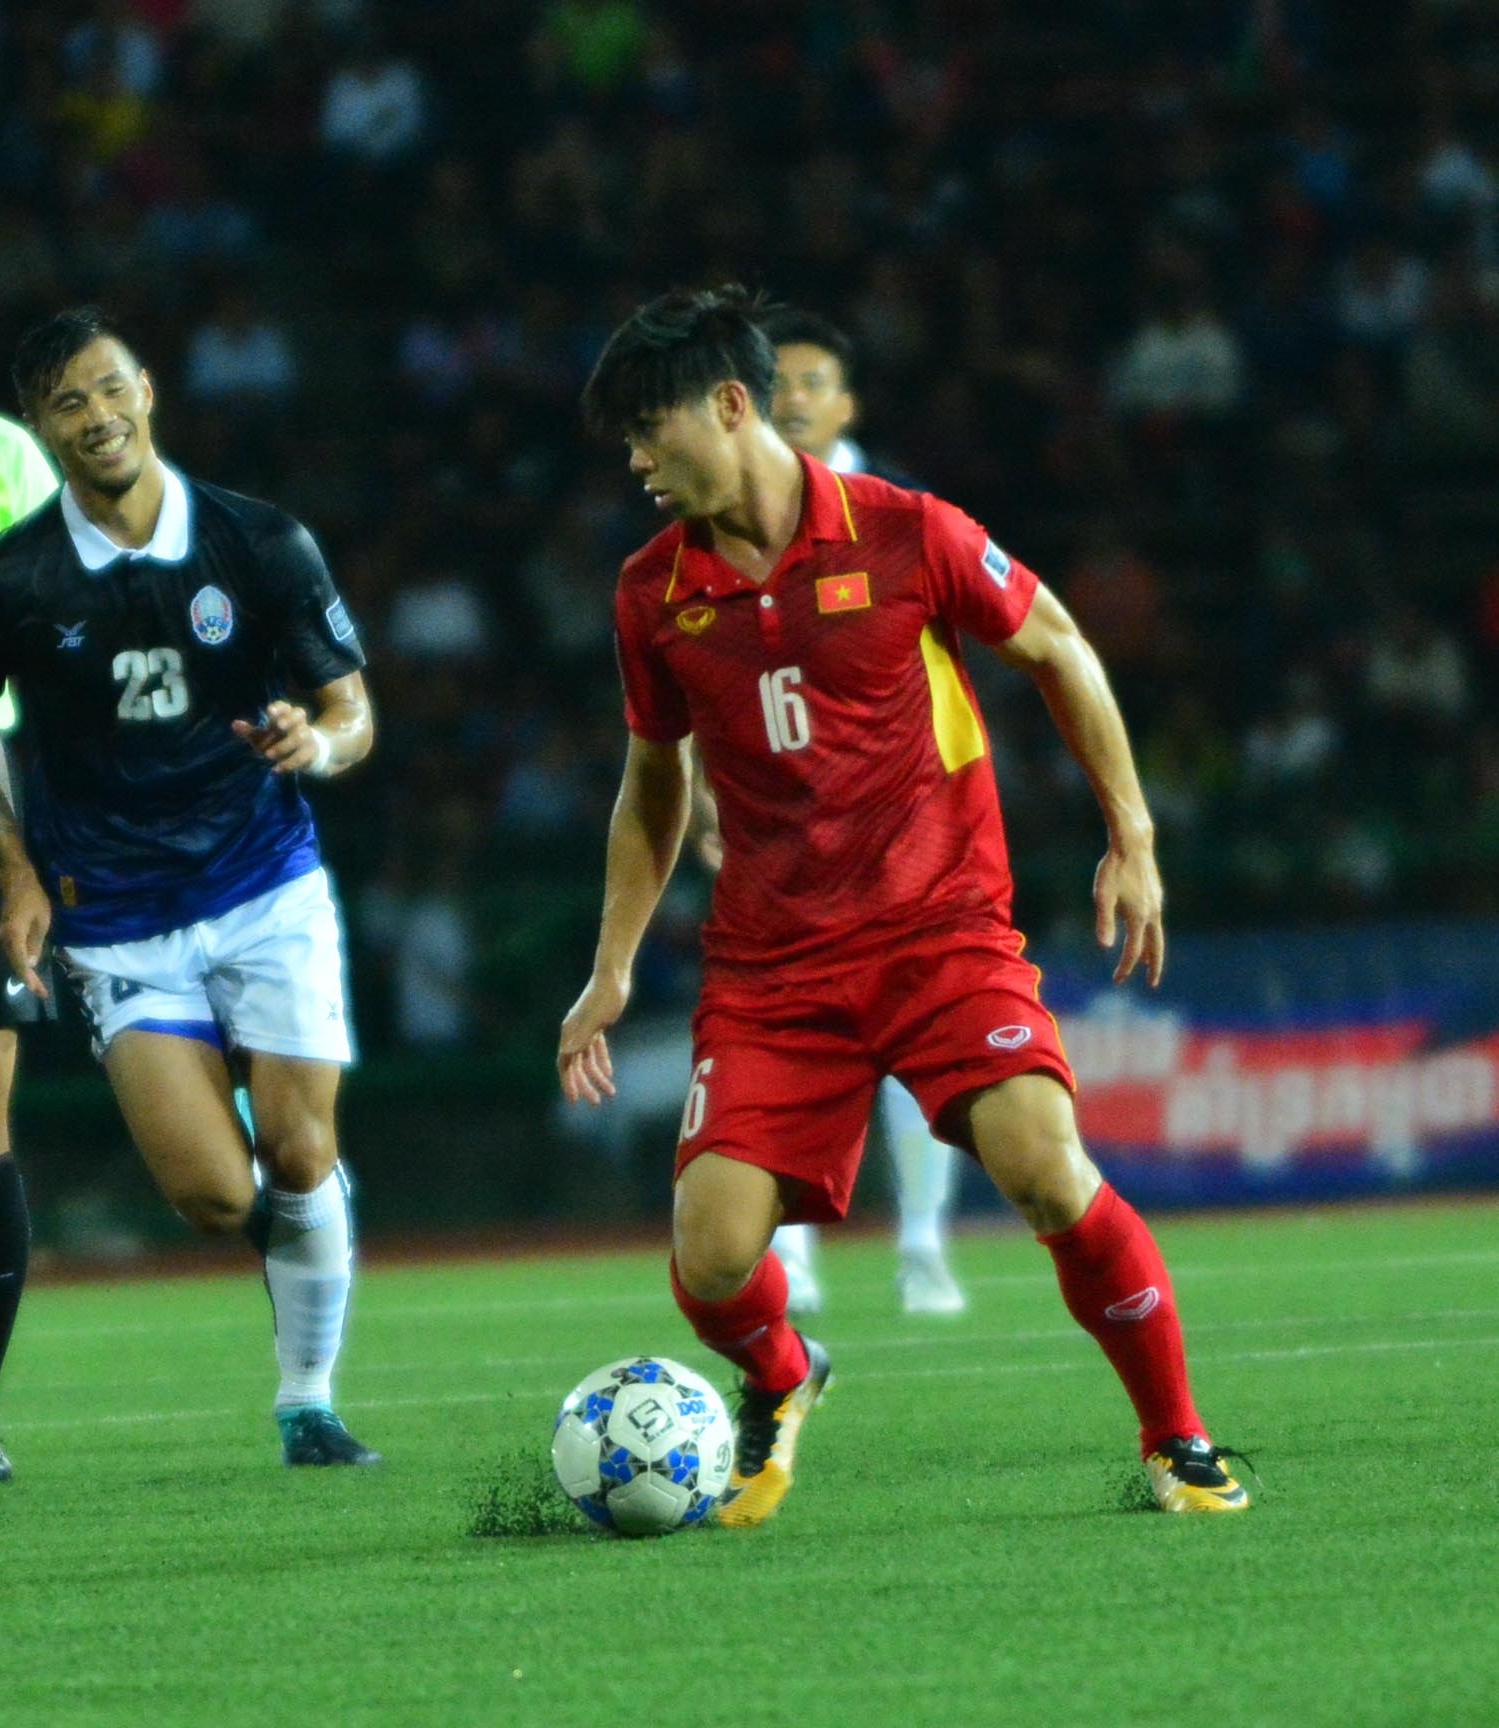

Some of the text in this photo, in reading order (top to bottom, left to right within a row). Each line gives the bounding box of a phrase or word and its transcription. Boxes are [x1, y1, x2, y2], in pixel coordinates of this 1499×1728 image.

[112, 648, 190, 721] 23
[758, 666, 811, 754] 16
[679, 1057, 714, 1143] 6
